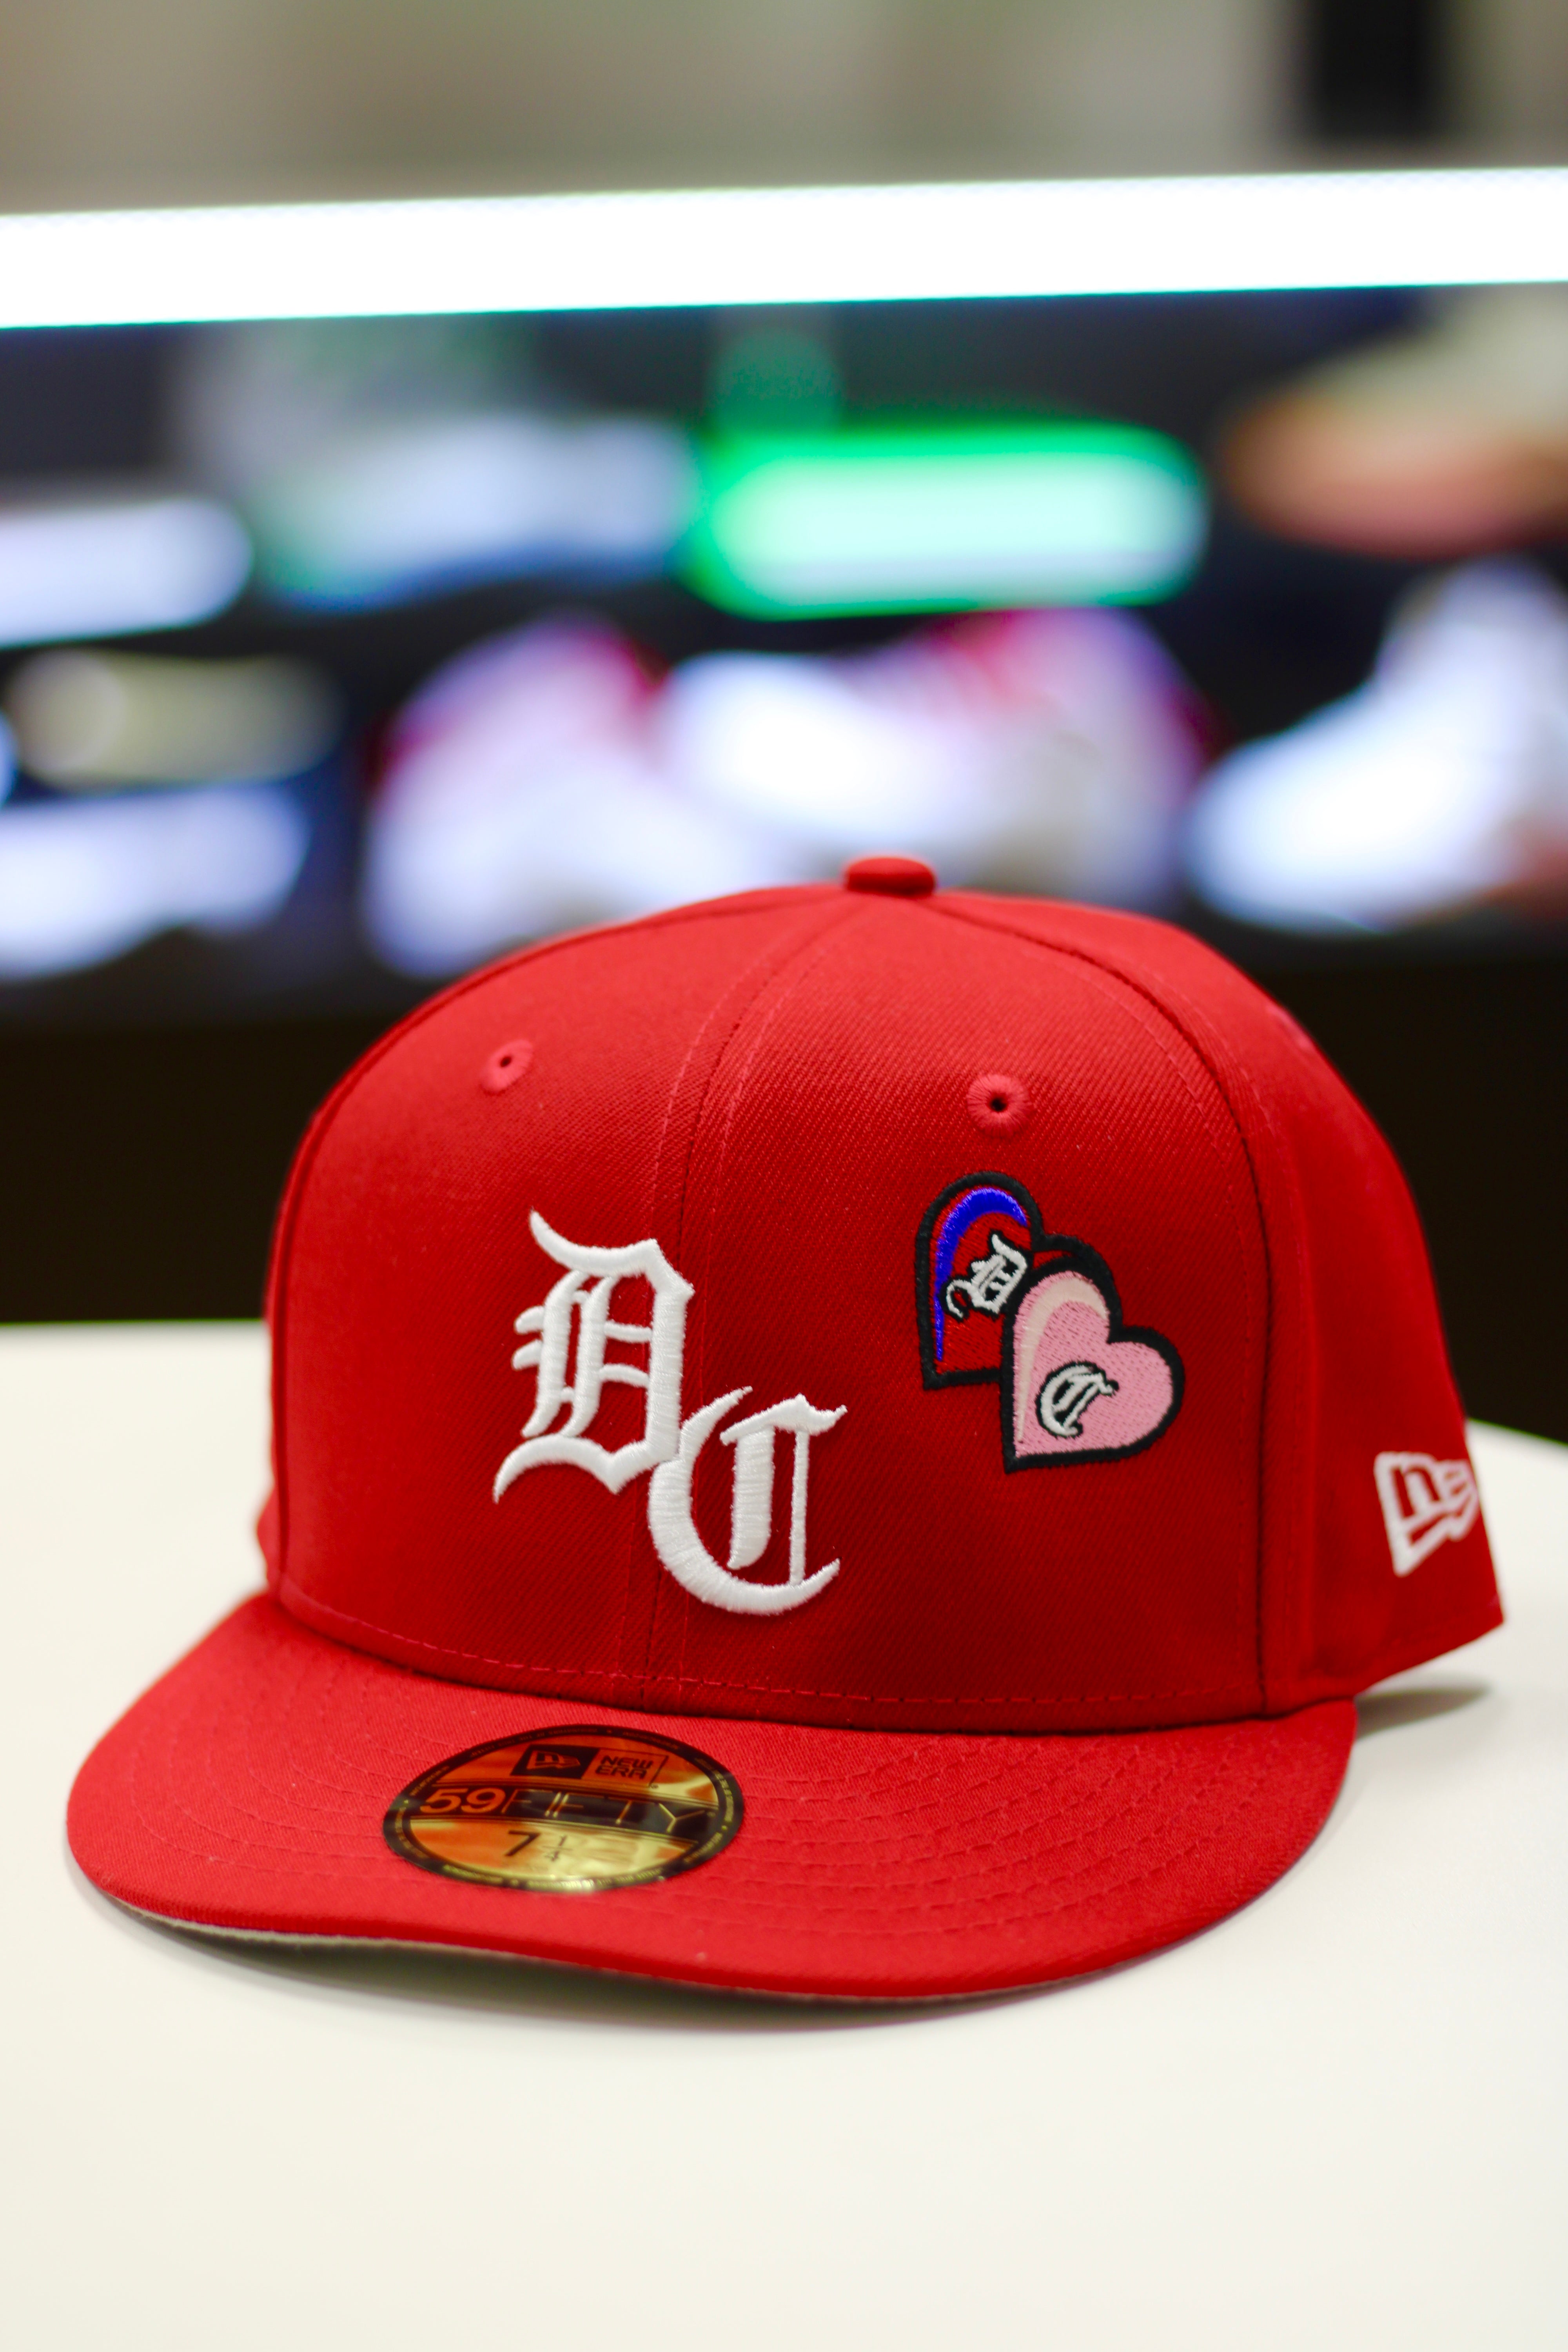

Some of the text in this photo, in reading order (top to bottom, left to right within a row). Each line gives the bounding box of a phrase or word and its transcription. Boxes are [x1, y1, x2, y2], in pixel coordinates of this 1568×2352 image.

[600, 1755, 653, 1769] NEW
[595, 1765, 648, 1779] ERA
[419, 1787, 705, 1833] 59FIFTY
